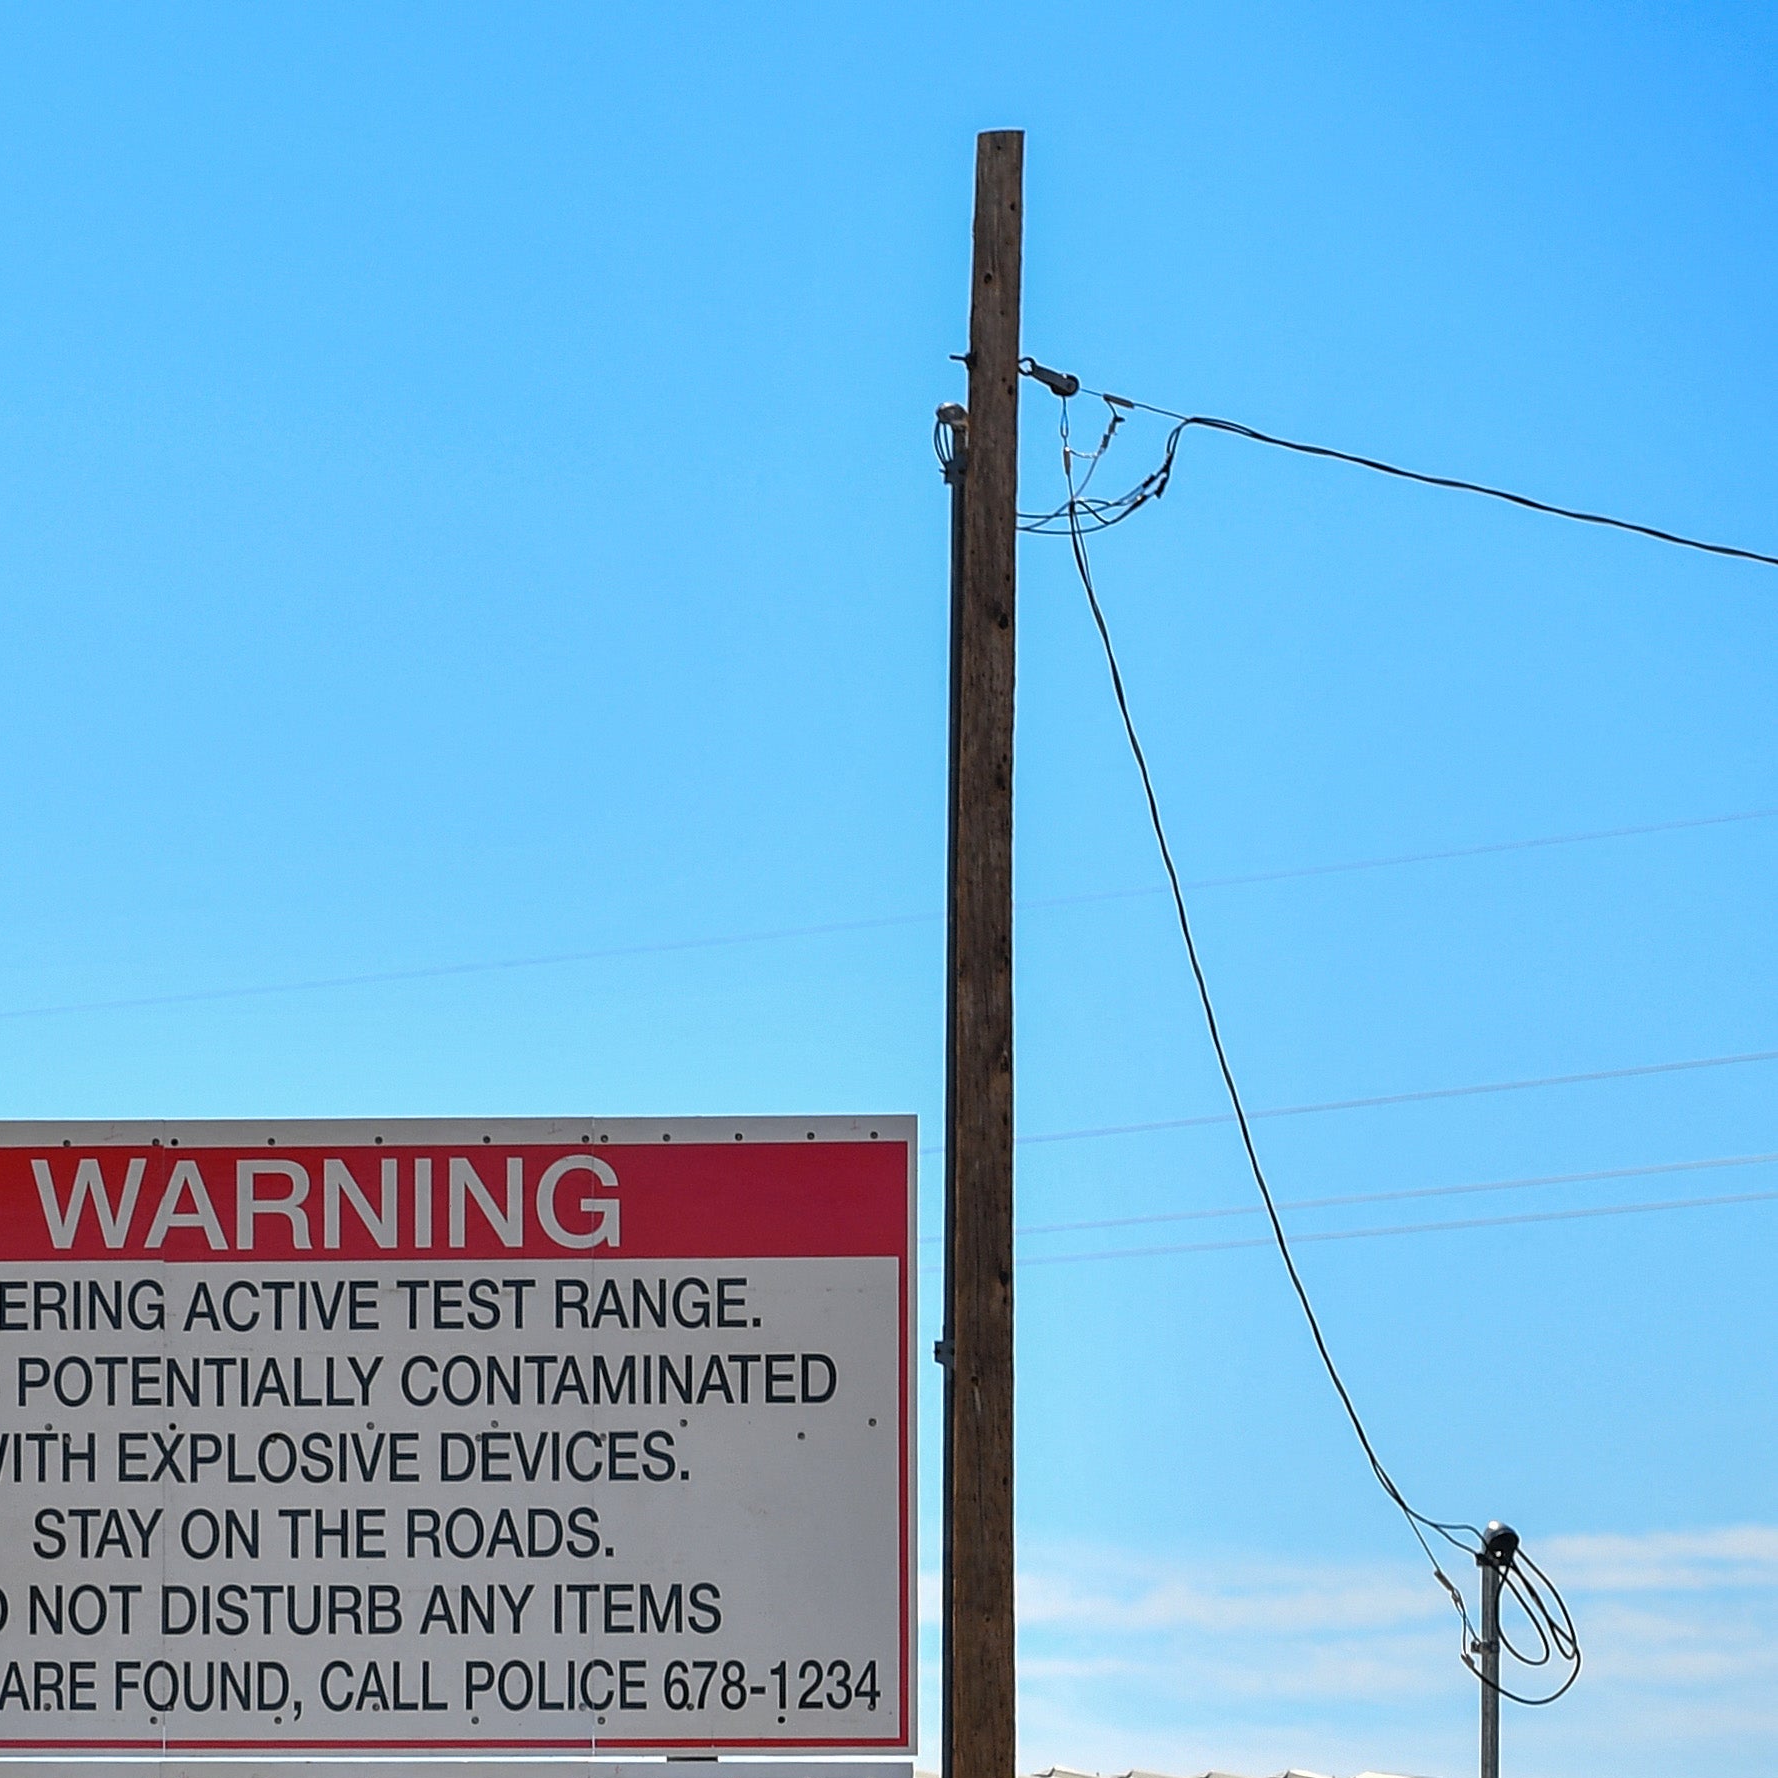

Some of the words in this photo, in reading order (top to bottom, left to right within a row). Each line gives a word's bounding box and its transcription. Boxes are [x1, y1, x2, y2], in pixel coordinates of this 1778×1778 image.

[30, 1155, 620, 1251] WARNING
[183, 1280, 379, 1332] ACTIVE
[396, 1278, 536, 1330] TEST
[555, 1277, 761, 1329] RANGE.
[18, 1355, 384, 1408] POTENTIALLY
[401, 1353, 837, 1407] CONTAMINATED
[118, 1432, 420, 1484] EXPLOSIVE
[440, 1430, 690, 1482] DEVICES.
[33, 1508, 164, 1560] STAY
[181, 1508, 259, 1560] ON
[278, 1508, 386, 1559] THE
[407, 1506, 614, 1559] ROADS.
[29, 1584, 143, 1636] NOT
[161, 1584, 402, 1636] DISTURB
[419, 1584, 535, 1635] ANY
[554, 1582, 722, 1634] ITEMS
[115, 1660, 302, 1721] FOUND,
[320, 1660, 448, 1712] CALL
[465, 1659, 647, 1713] POLICE
[664, 1659, 881, 1713] 678-1234
